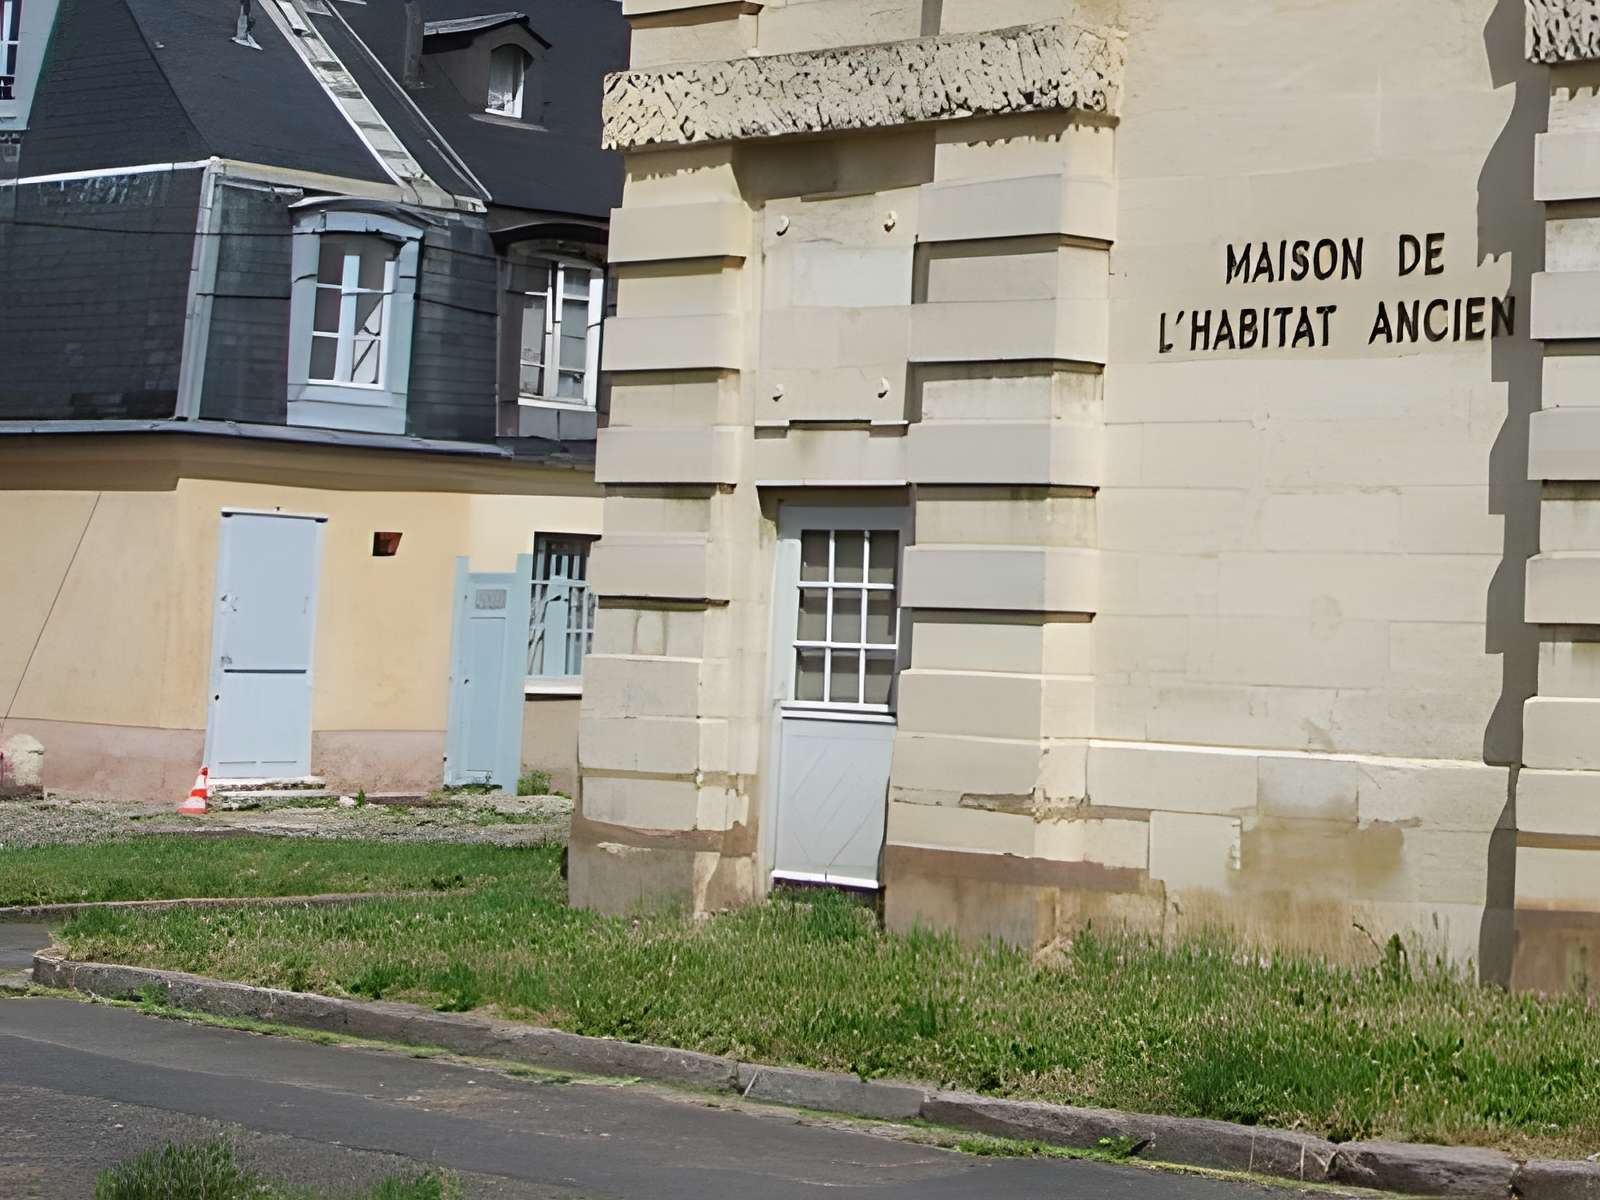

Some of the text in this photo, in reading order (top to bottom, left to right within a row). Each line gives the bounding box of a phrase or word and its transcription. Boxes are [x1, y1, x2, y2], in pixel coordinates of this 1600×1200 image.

[1226, 233, 1445, 284] MAISON DE
[1158, 296, 1516, 354] L'HABITAT ANCIEN
